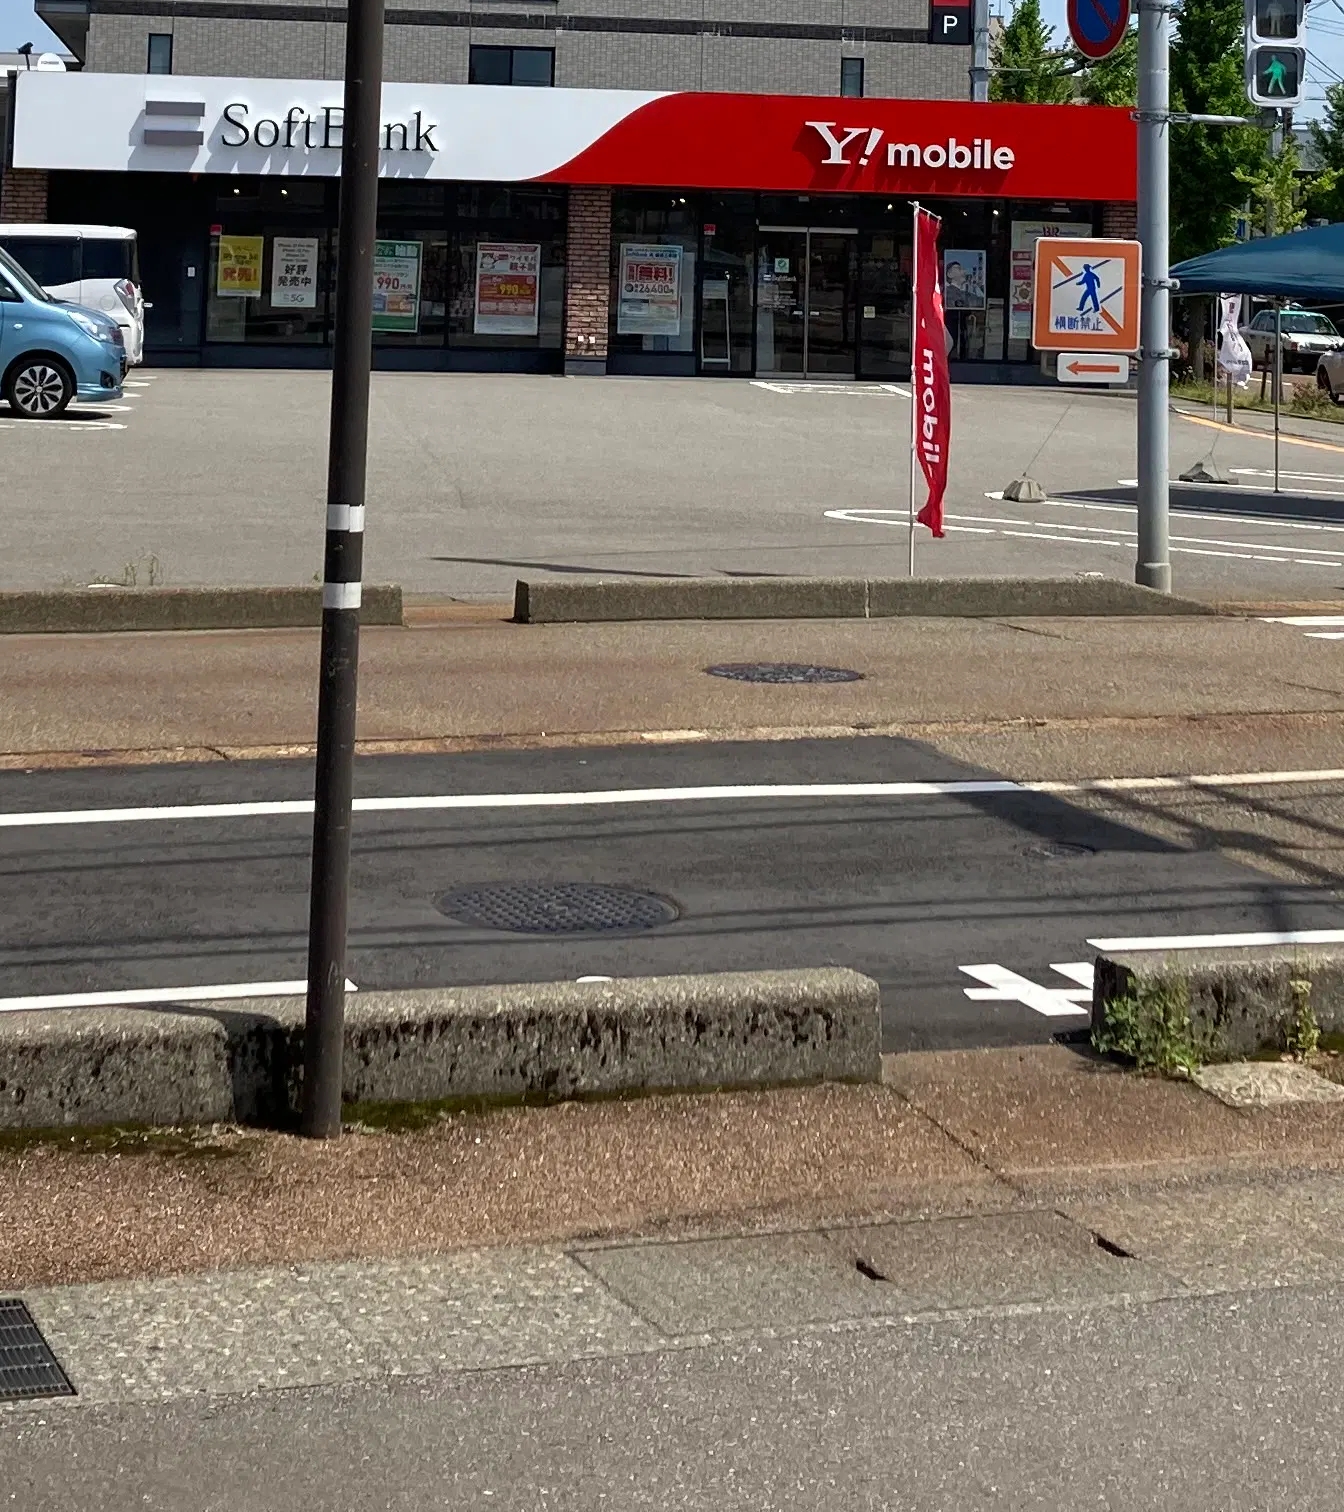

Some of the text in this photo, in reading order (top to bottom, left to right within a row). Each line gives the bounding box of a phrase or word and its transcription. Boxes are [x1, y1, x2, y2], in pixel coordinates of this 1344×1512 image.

[943, 15, 958, 34] P
[220, 102, 440, 152] SoftBnk
[277, 275, 312, 287] 発売中
[1054, 315, 1104, 332] 横断禁止
